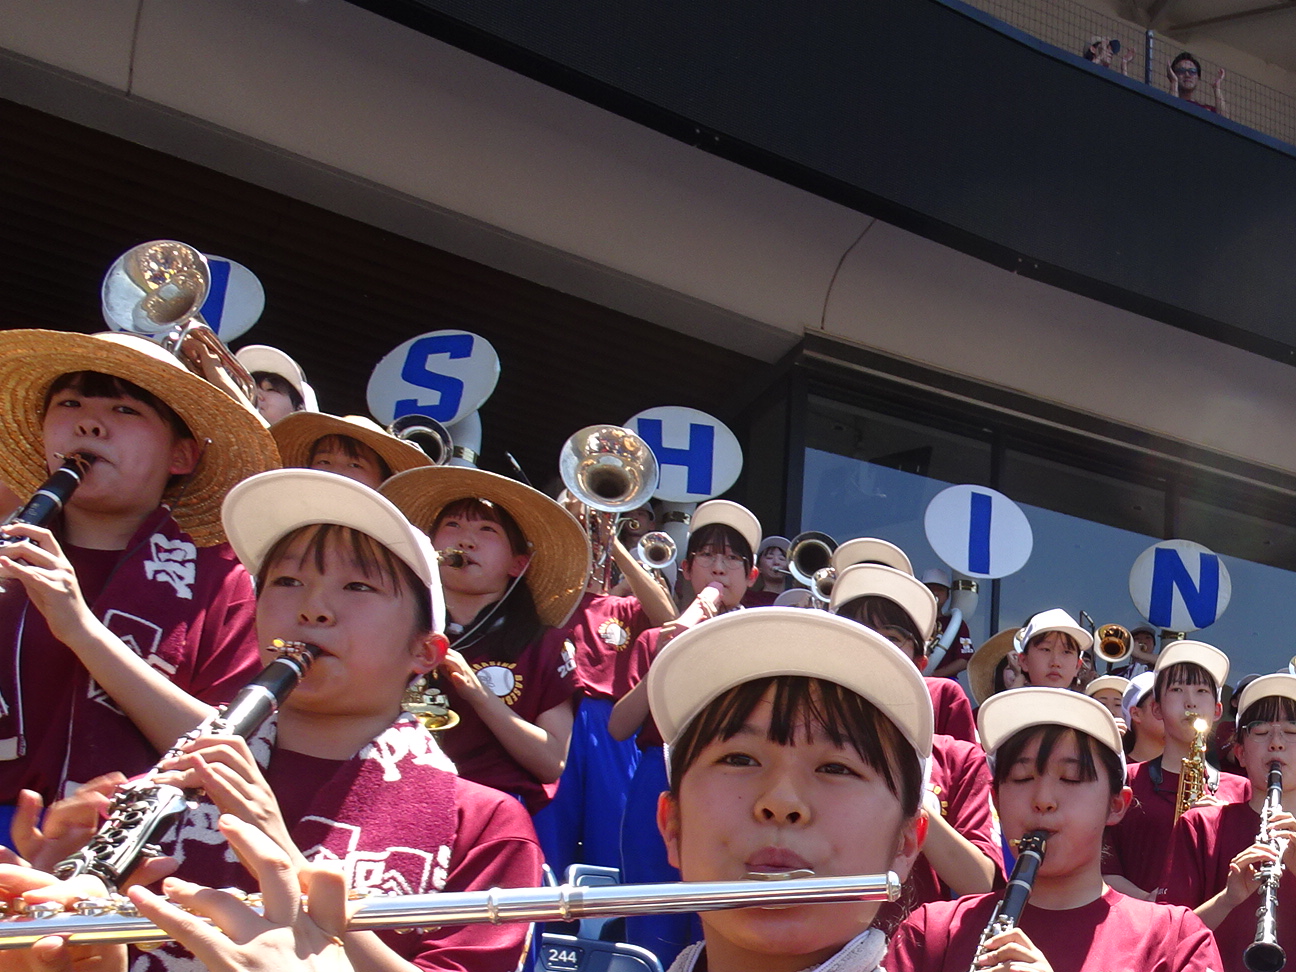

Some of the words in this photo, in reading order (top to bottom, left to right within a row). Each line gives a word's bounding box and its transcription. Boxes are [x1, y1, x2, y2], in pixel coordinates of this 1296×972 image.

[394, 334, 475, 423] S
[637, 418, 715, 496] H
[968, 491, 993, 575] I
[1149, 547, 1219, 628] N
[557, 659, 577, 678] 20
[549, 949, 577, 963] 244
